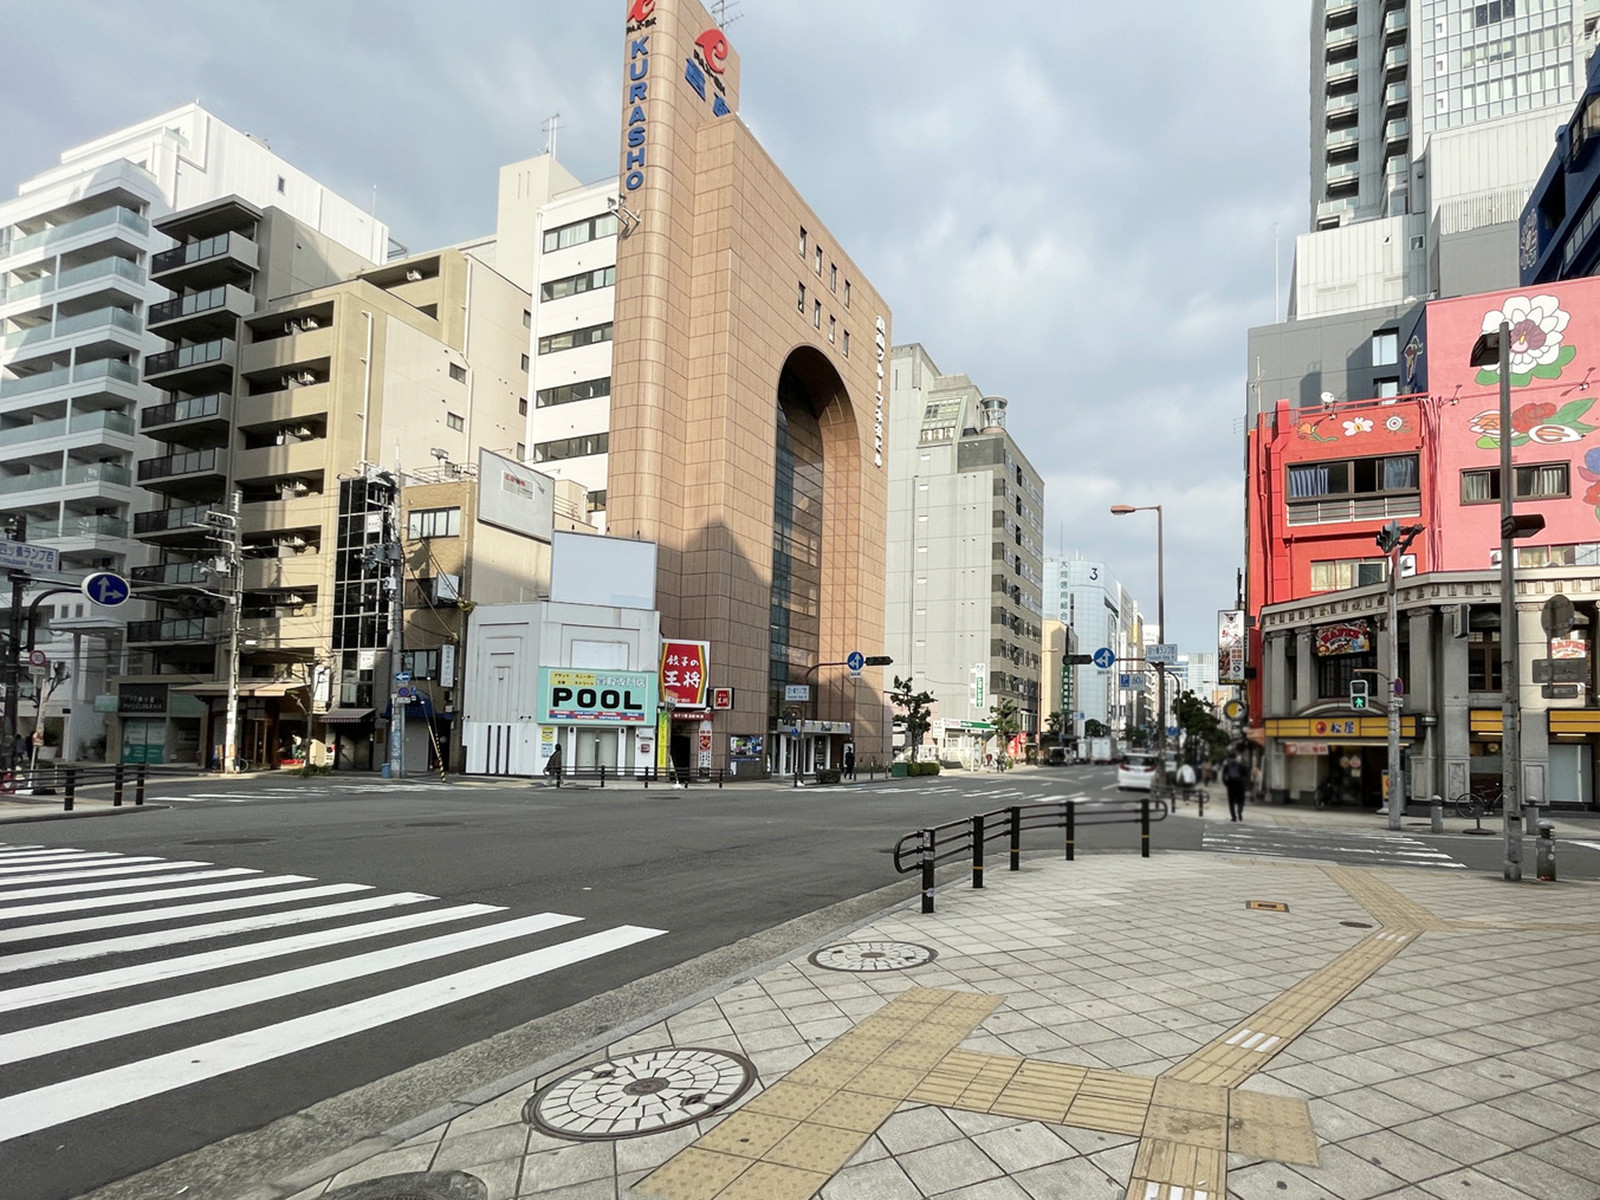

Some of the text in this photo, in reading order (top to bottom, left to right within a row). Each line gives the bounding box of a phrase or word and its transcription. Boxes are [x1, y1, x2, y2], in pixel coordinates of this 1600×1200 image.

[625, 35, 650, 190] KURASHO
[1089, 567, 1099, 581] 3
[667, 654, 699, 667] 餃子の
[664, 670, 701, 689] 王将
[553, 688, 643, 710] POOL
[1330, 720, 1355, 734] 松屋
